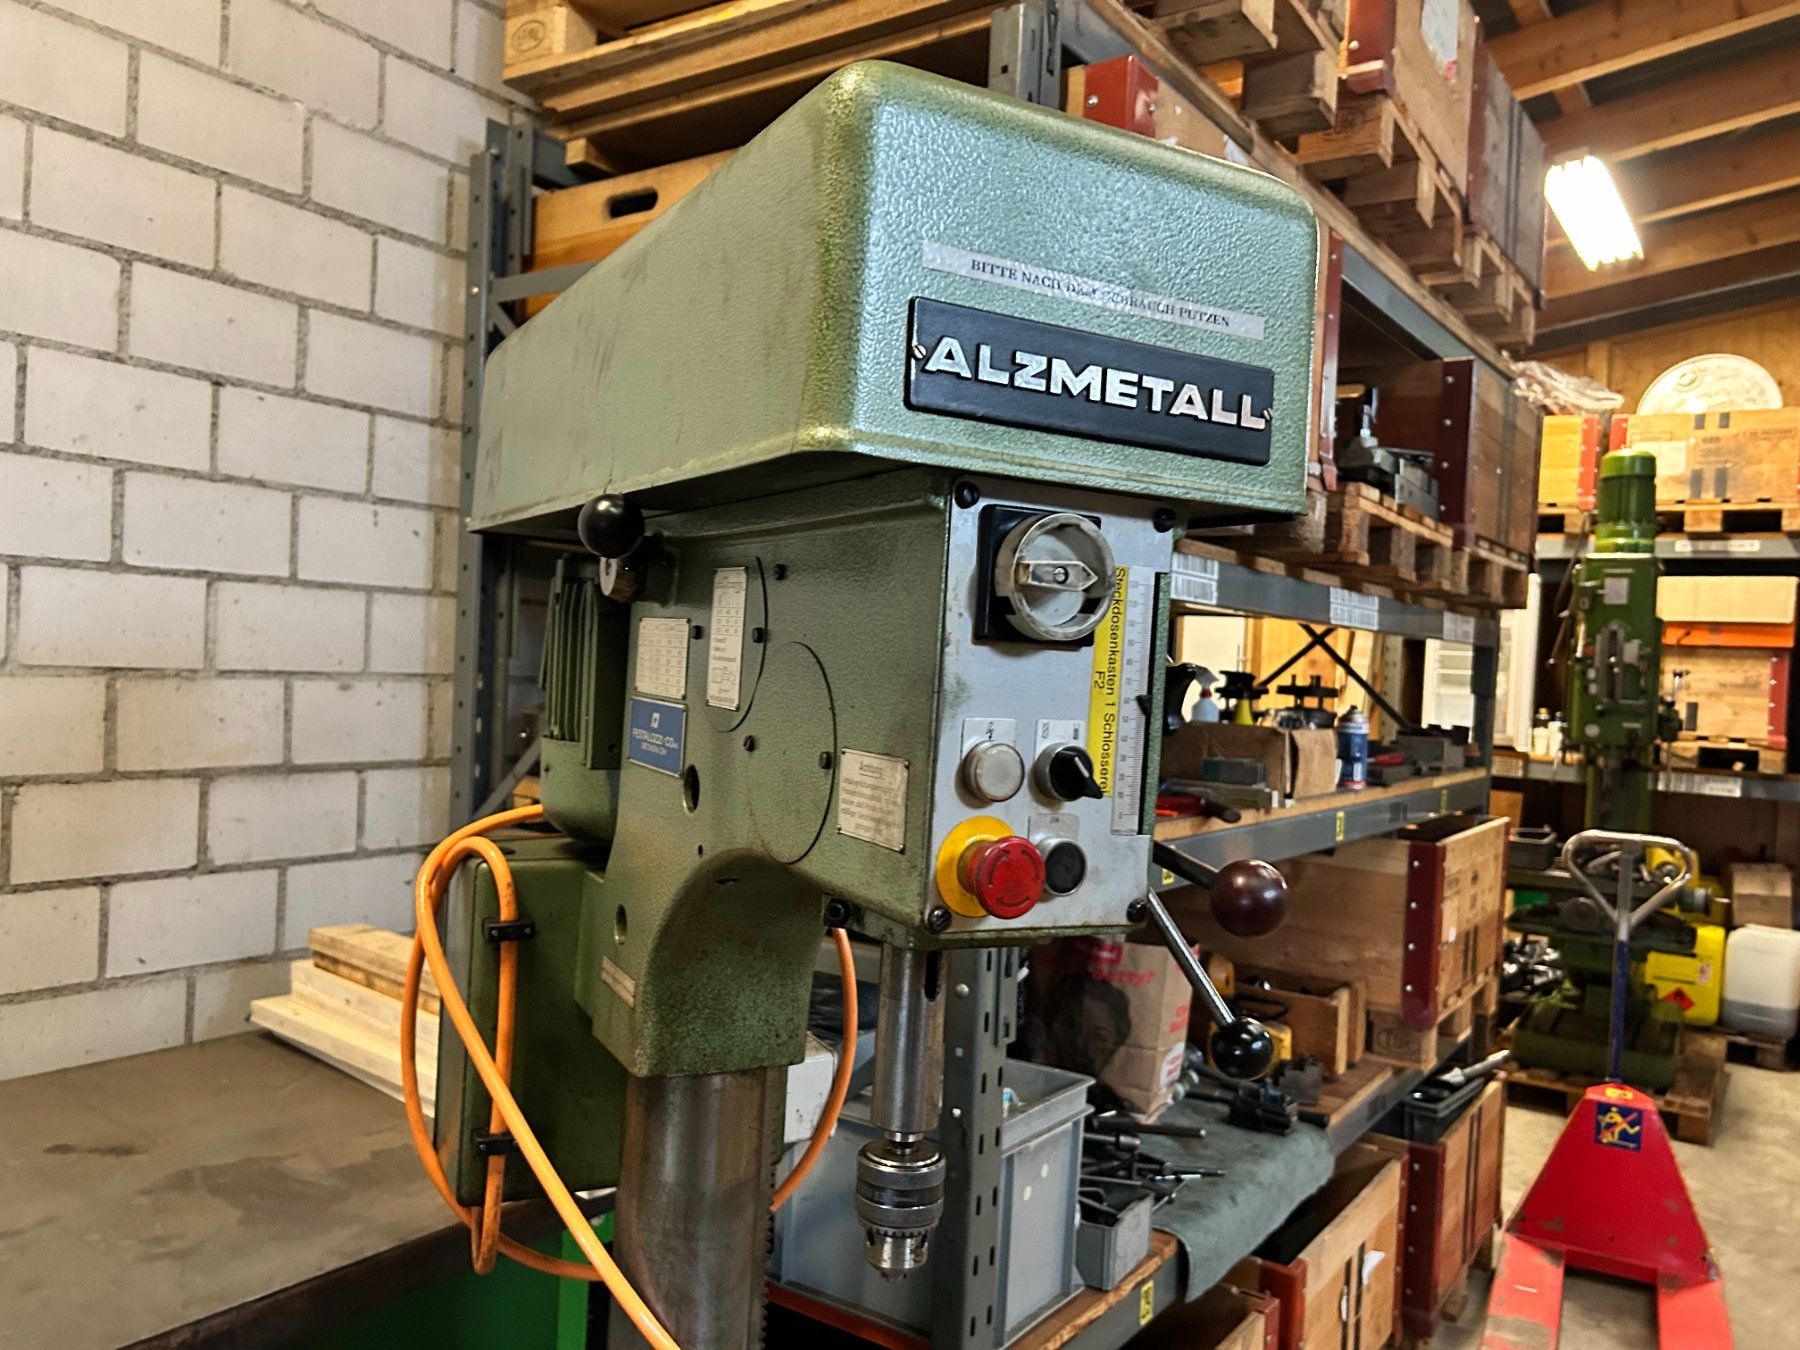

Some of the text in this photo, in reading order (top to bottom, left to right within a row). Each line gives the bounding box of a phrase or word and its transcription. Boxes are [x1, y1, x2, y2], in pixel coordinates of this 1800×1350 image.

[970, 259, 1018, 281] BITTE
[1178, 307, 1231, 328] PUTZEN
[923, 335, 1266, 430] ALZMETALL
[1093, 670, 1105, 690] F2
[1099, 712, 1116, 795] Schlosserei
